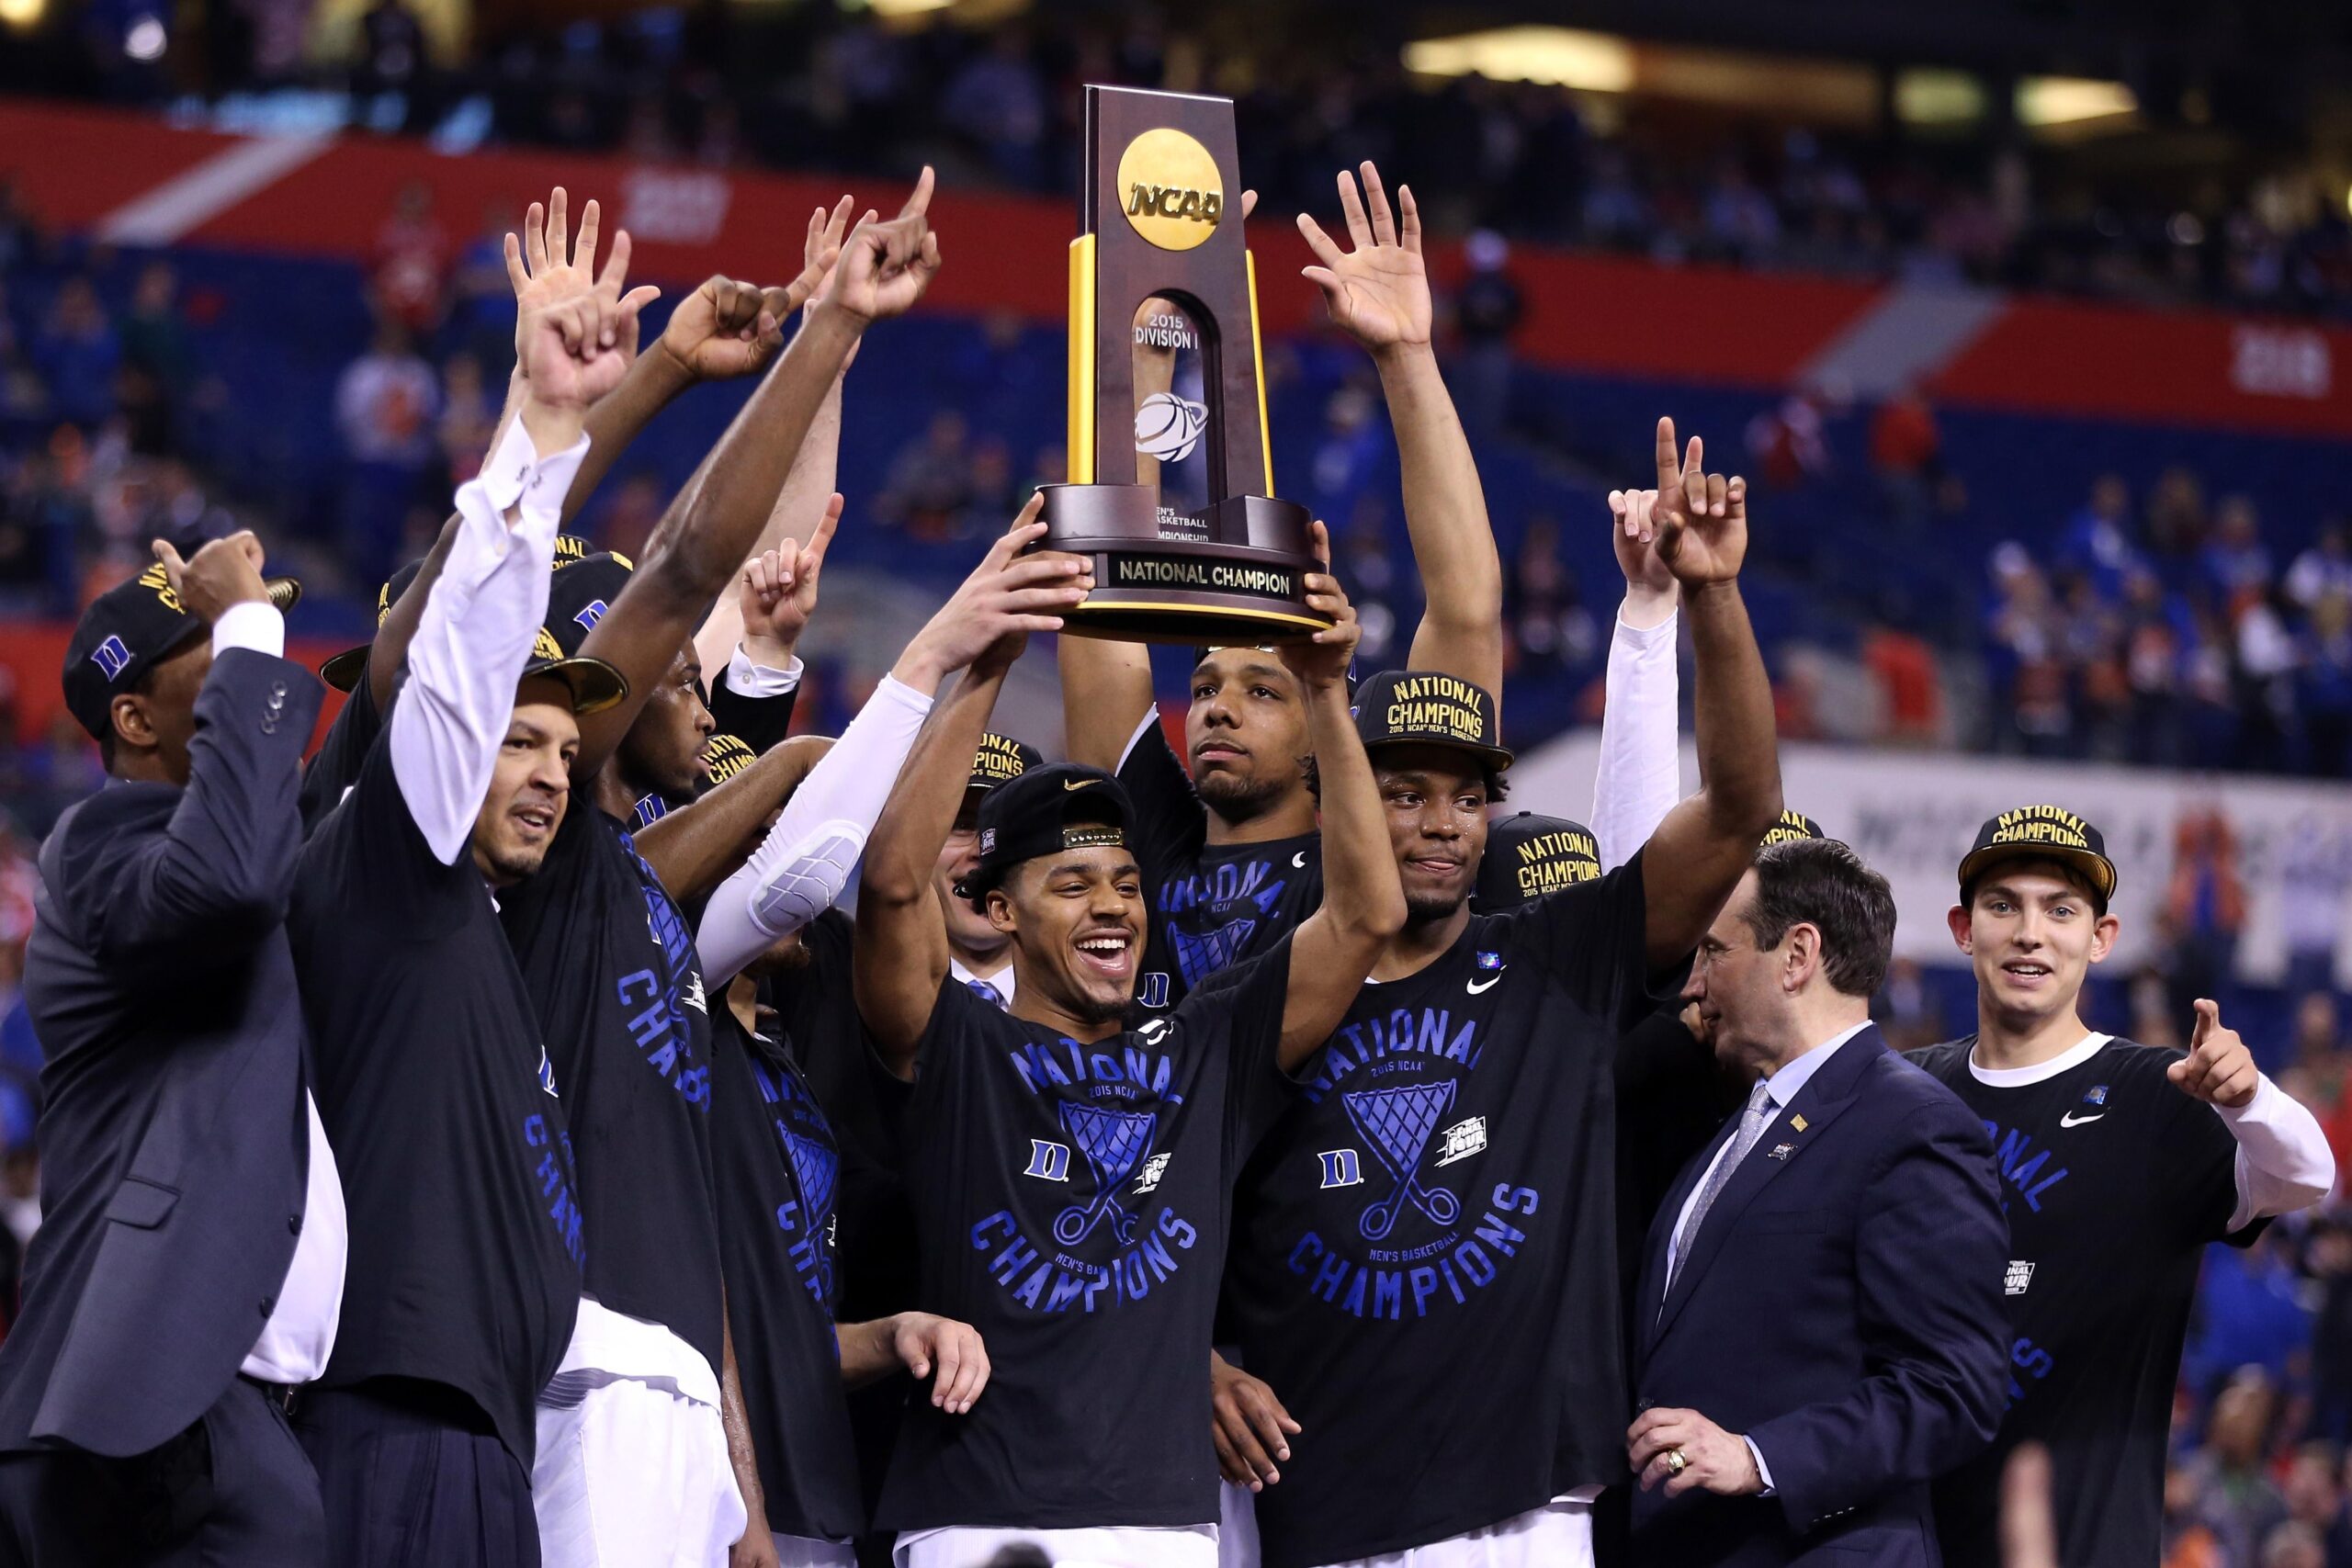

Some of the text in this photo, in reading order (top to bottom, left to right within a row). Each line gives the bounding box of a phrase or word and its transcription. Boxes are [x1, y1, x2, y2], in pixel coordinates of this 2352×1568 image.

[1127, 183, 1221, 225] NCAA
[1149, 314, 1183, 329] 2015
[1136, 327, 1198, 350] DIVISION I
[1156, 506, 1175, 516] EN'S
[1158, 515, 1208, 528] SKETBALL
[1158, 530, 1209, 542] MPIONSHIP
[1120, 561, 1290, 594] NATIONAL CHAMPION
[1393, 676, 1482, 716] NATIONAL
[1387, 702, 1482, 739] CHAMPIONS
[1388, 726, 1404, 734] 2015
[1428, 725, 1448, 734] MEN'S
[974, 751, 1023, 776] PIONS
[1998, 805, 2086, 840] NATIONAL
[1517, 832, 1597, 864] NATIONAL
[1518, 860, 1601, 889] CHAMPIONS
[1522, 888, 1538, 897] 2015
[1152, 1158, 1169, 1170] FIN
[1288, 1182, 1539, 1320] CHAMPIONS
[1369, 1230, 1461, 1262] MEN'S BASKETBALL
[970, 1207, 1197, 1313] CHAMPIONS
[1055, 1252, 1084, 1272] MEN'S
[2006, 1266, 2029, 1276] INAL
